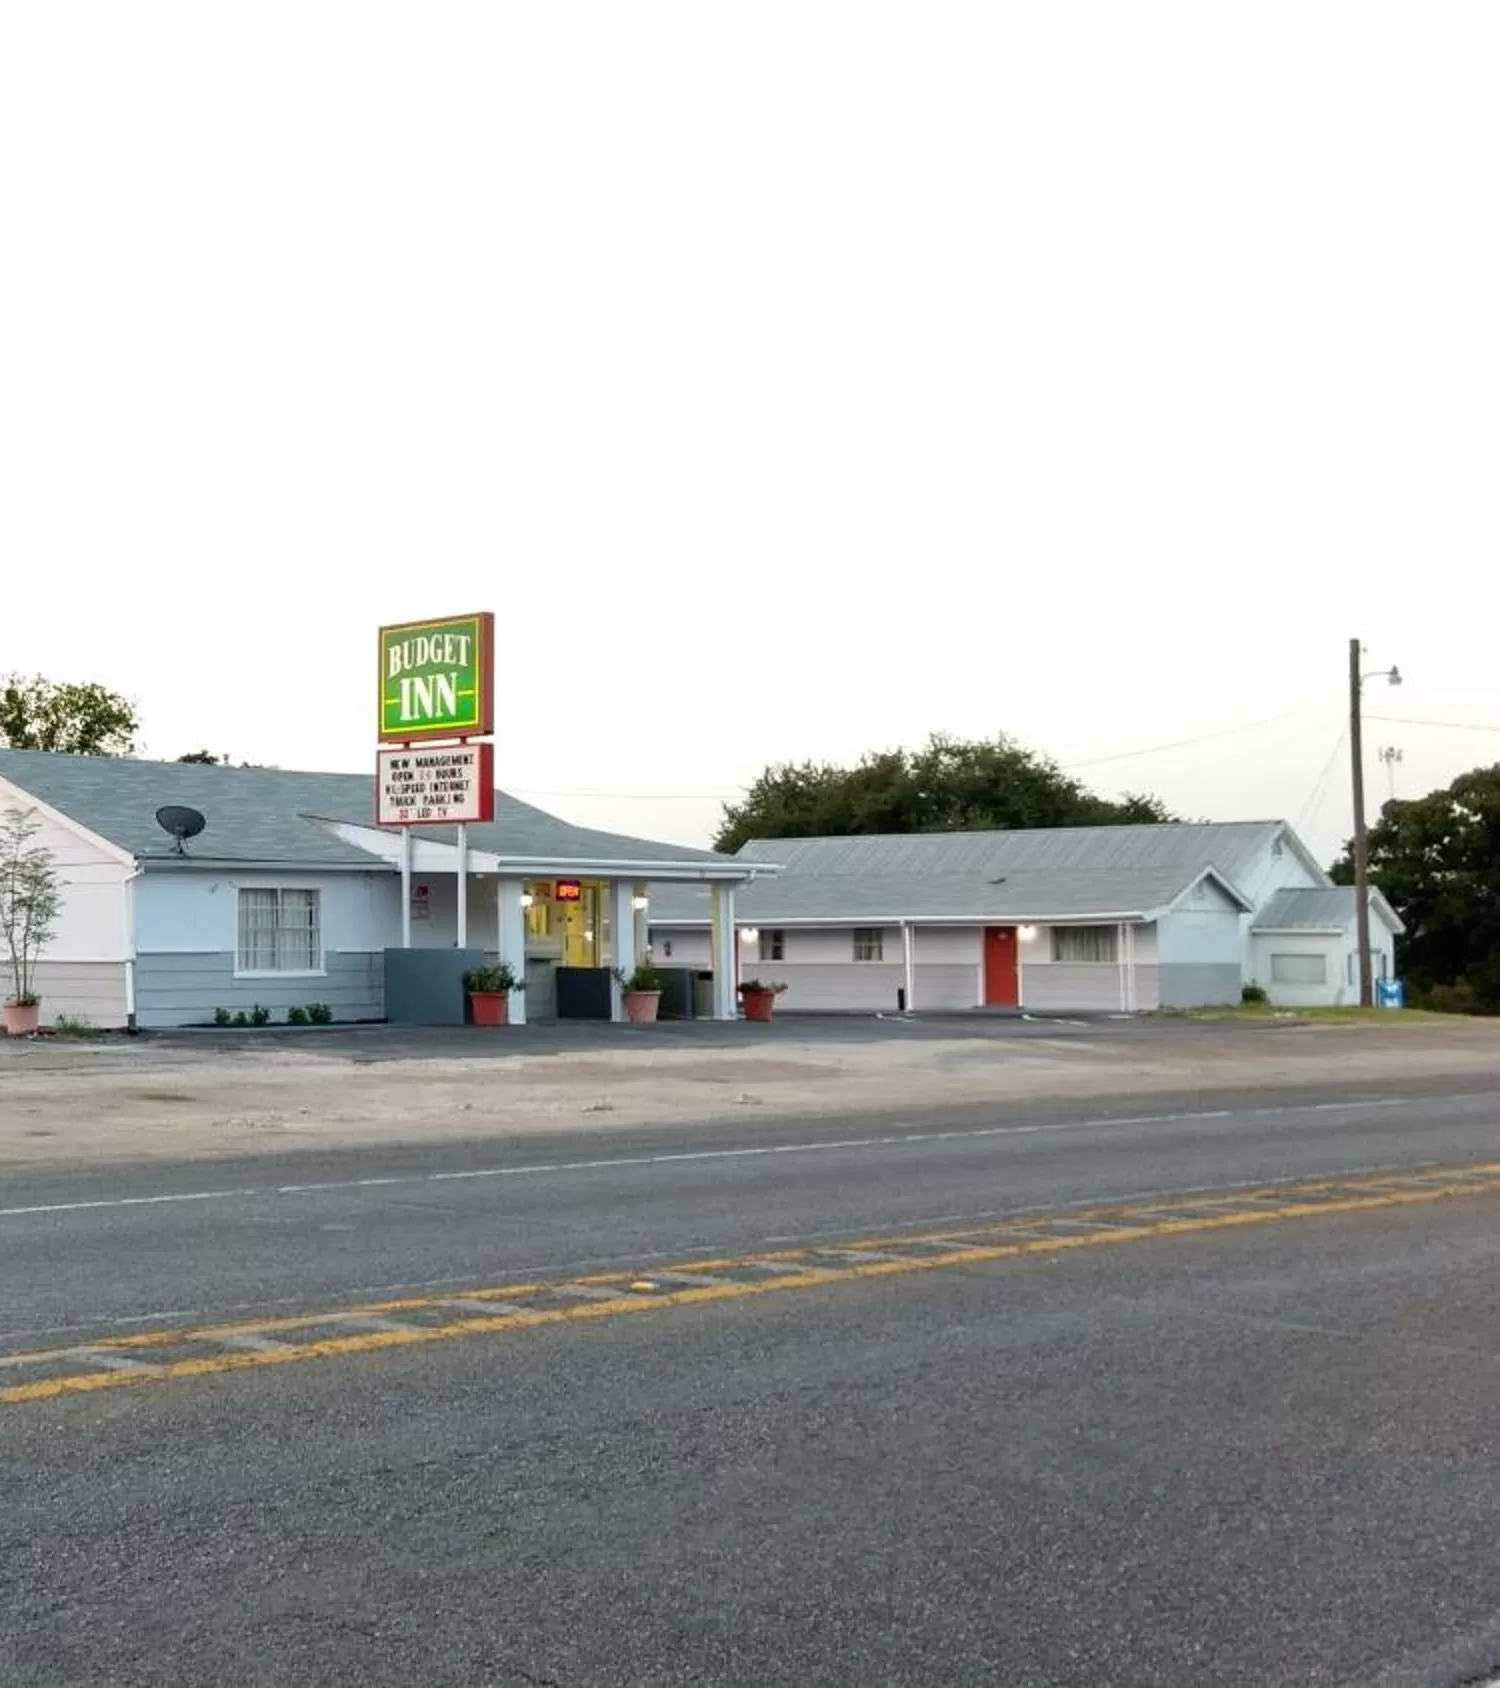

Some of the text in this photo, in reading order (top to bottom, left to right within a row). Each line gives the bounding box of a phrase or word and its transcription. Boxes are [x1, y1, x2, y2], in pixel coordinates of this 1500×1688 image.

[388, 633, 471, 679] BUDGET
[400, 672, 458, 720] INN
[390, 754, 474, 769] NEW MANAGEMENT
[392, 771, 414, 781] OPEN
[436, 768, 463, 779] HOURS
[430, 780, 469, 792] INTERNET
[390, 794, 465, 807] TRUCK PARKING
